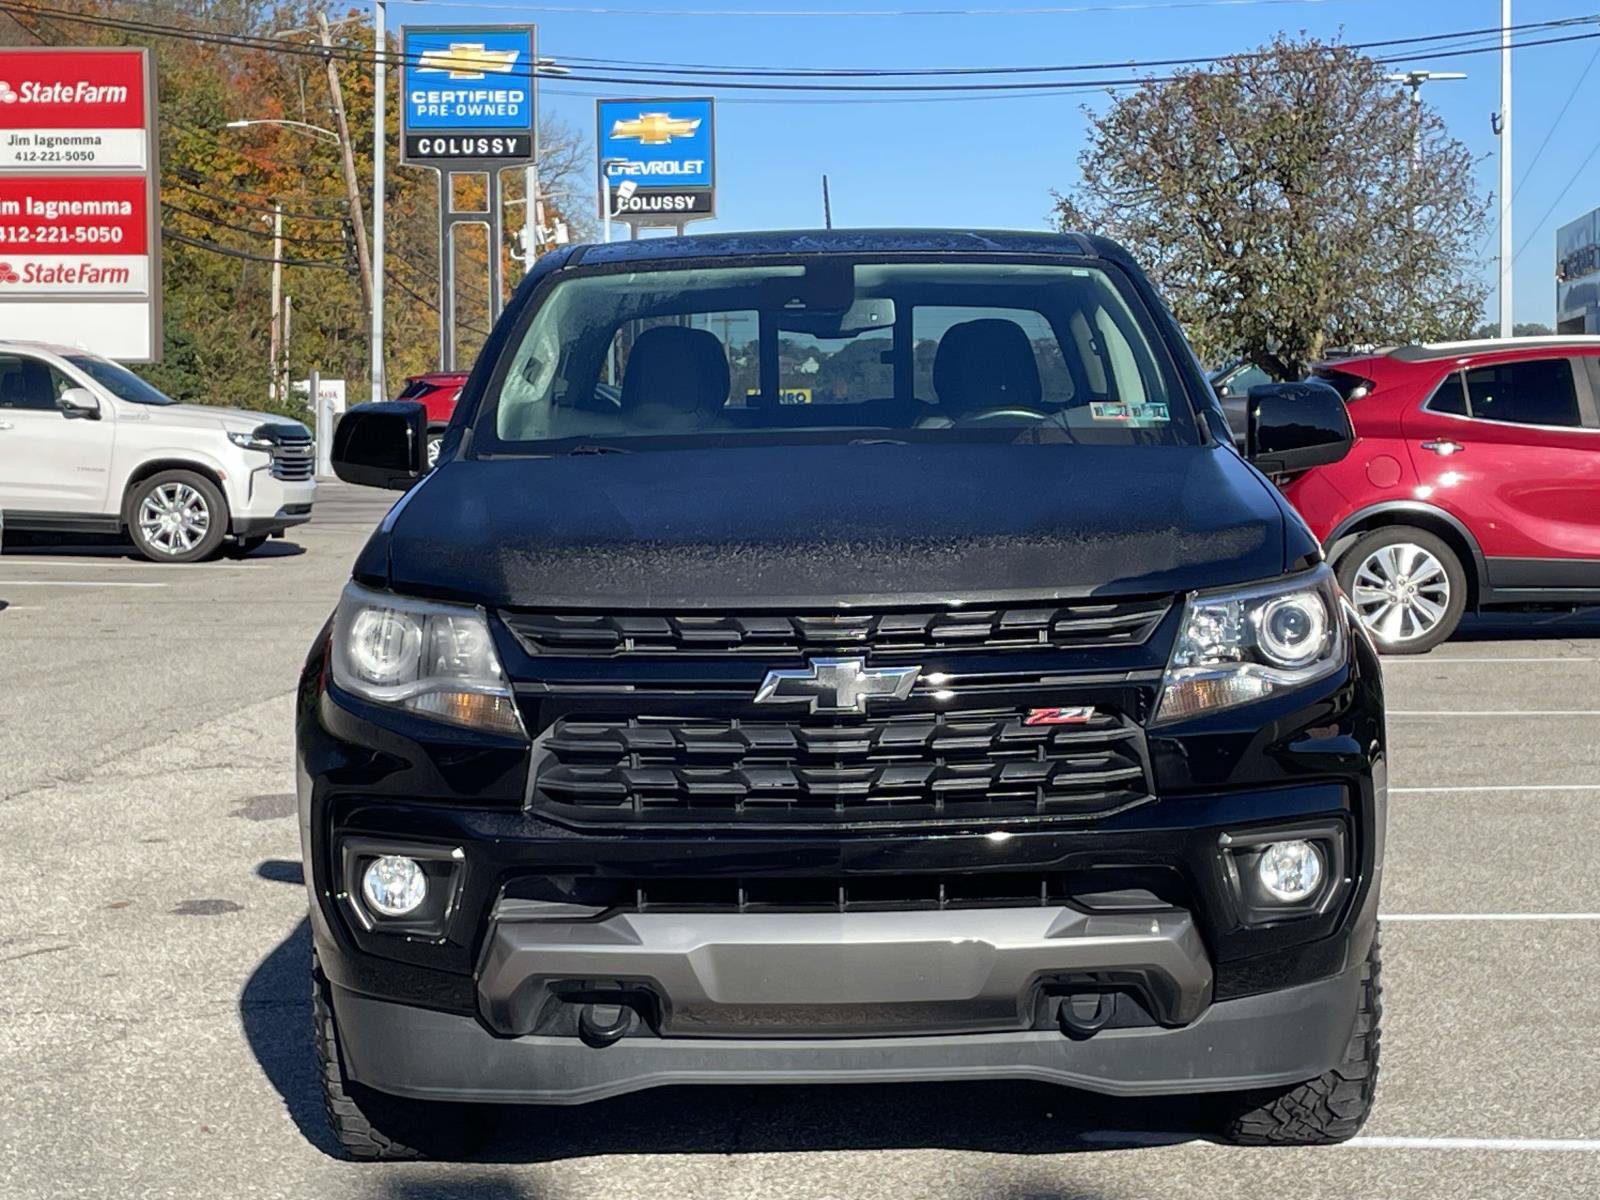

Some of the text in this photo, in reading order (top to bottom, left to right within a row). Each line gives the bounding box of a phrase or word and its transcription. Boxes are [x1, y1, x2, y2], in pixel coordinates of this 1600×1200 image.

[411, 90, 525, 103] CERTIFIED
[417, 104, 519, 117] PRE-OWNED
[7, 134, 102, 148] Jim Iagnemma
[418, 138, 518, 154] COLUSSY
[14, 151, 95, 162] 412-221-5050
[26, 196, 132, 219] Iagnemma
[617, 196, 696, 211] COLUSSY
